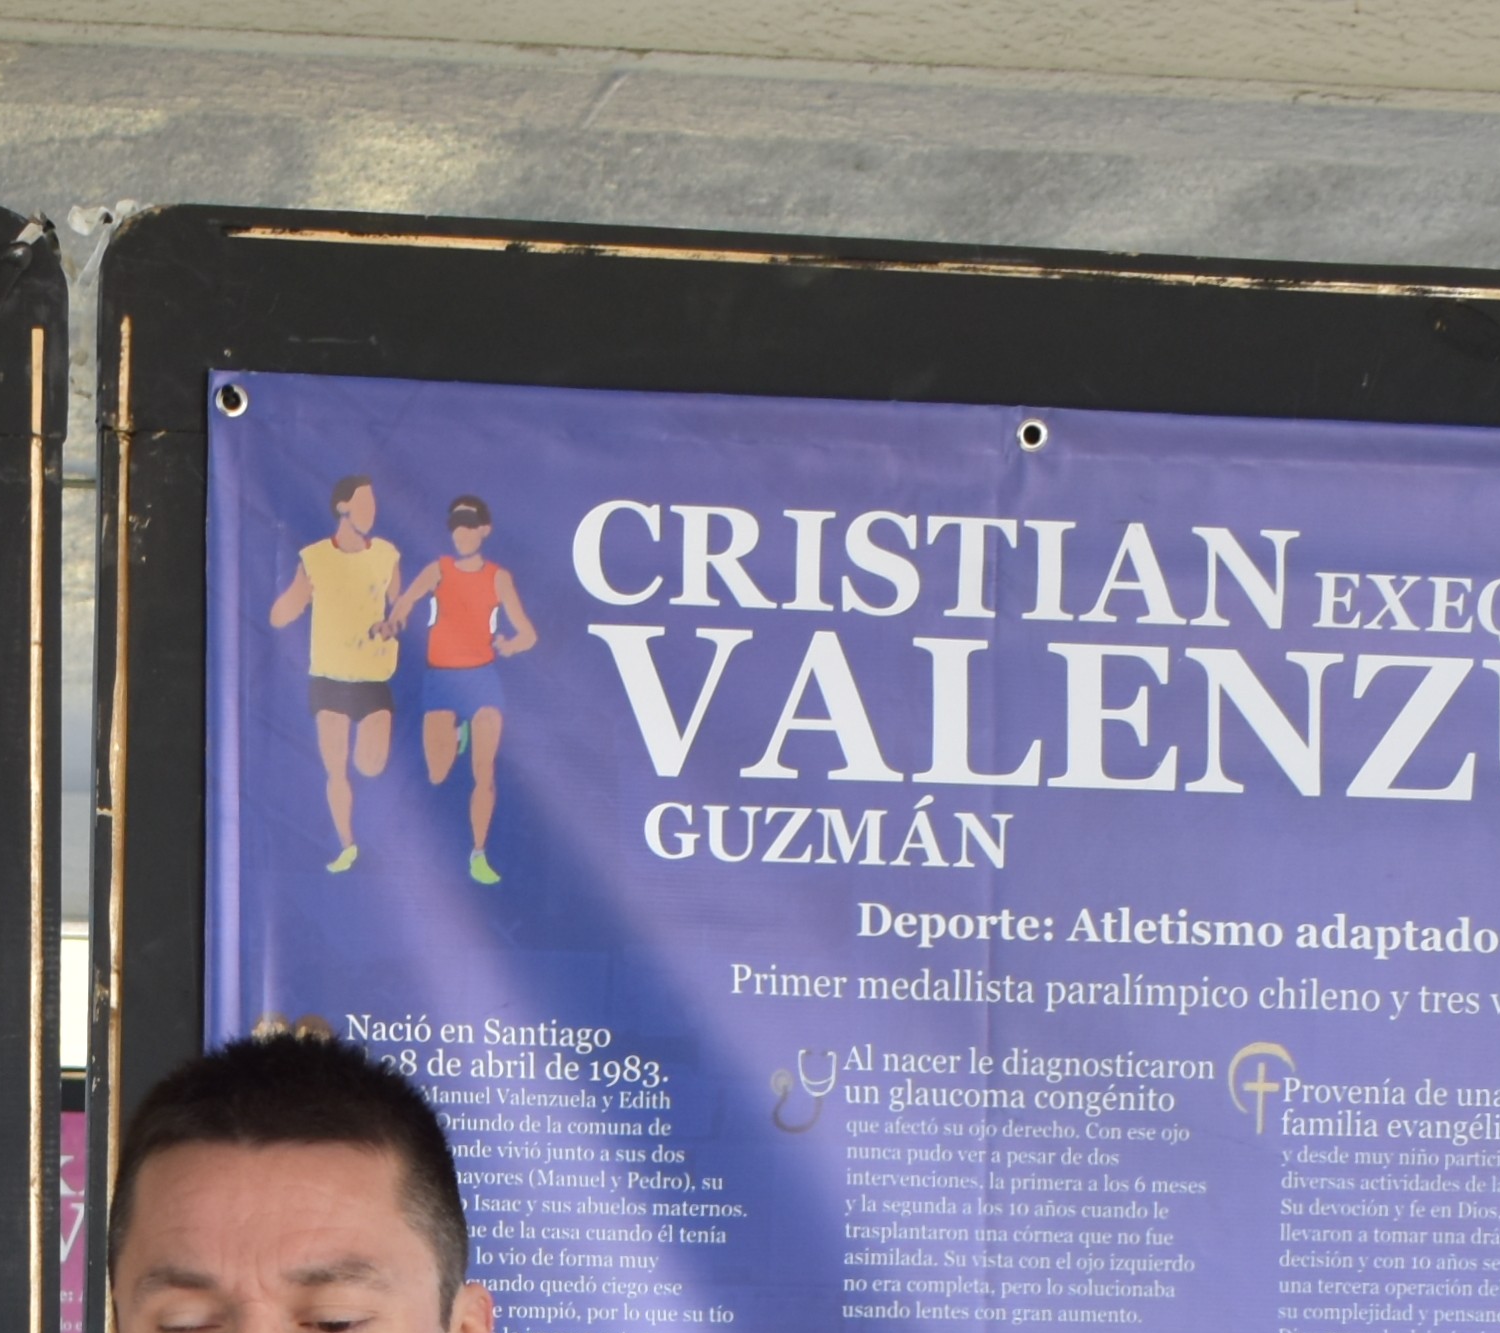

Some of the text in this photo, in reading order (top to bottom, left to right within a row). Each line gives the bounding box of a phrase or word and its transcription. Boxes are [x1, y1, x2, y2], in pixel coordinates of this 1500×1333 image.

[573, 500, 1300, 629] CRISTIAN
[644, 796, 1013, 868] GUZMÁN
[856, 902, 1054, 949] Deporte:
[1066, 906, 1284, 948] Atletismo
[1295, 913, 1499, 960] adaptado
[730, 963, 848, 998] Primer
[857, 967, 1035, 1004] medallista
[1045, 972, 1249, 1016] paralímpico
[1258, 976, 1381, 1012] chileno
[1389, 990, 1410, 1021] y
[1418, 985, 1480, 1015] tres
[345, 1013, 612, 1055] Nació en Santiago
[381, 1048, 670, 1088] 28 de abril de 1983.
[842, 1043, 1215, 1084] Al nacer le diagnosticaron
[844, 1077, 1175, 1117] un glaucoma congénito
[1283, 1077, 1406, 1105] Provenía
[1414, 1078, 1448, 1106] de
[846, 1117, 1190, 1146] que afectó su ojo derecho. Con ese ojo
[1281, 1108, 1379, 1138] familia
